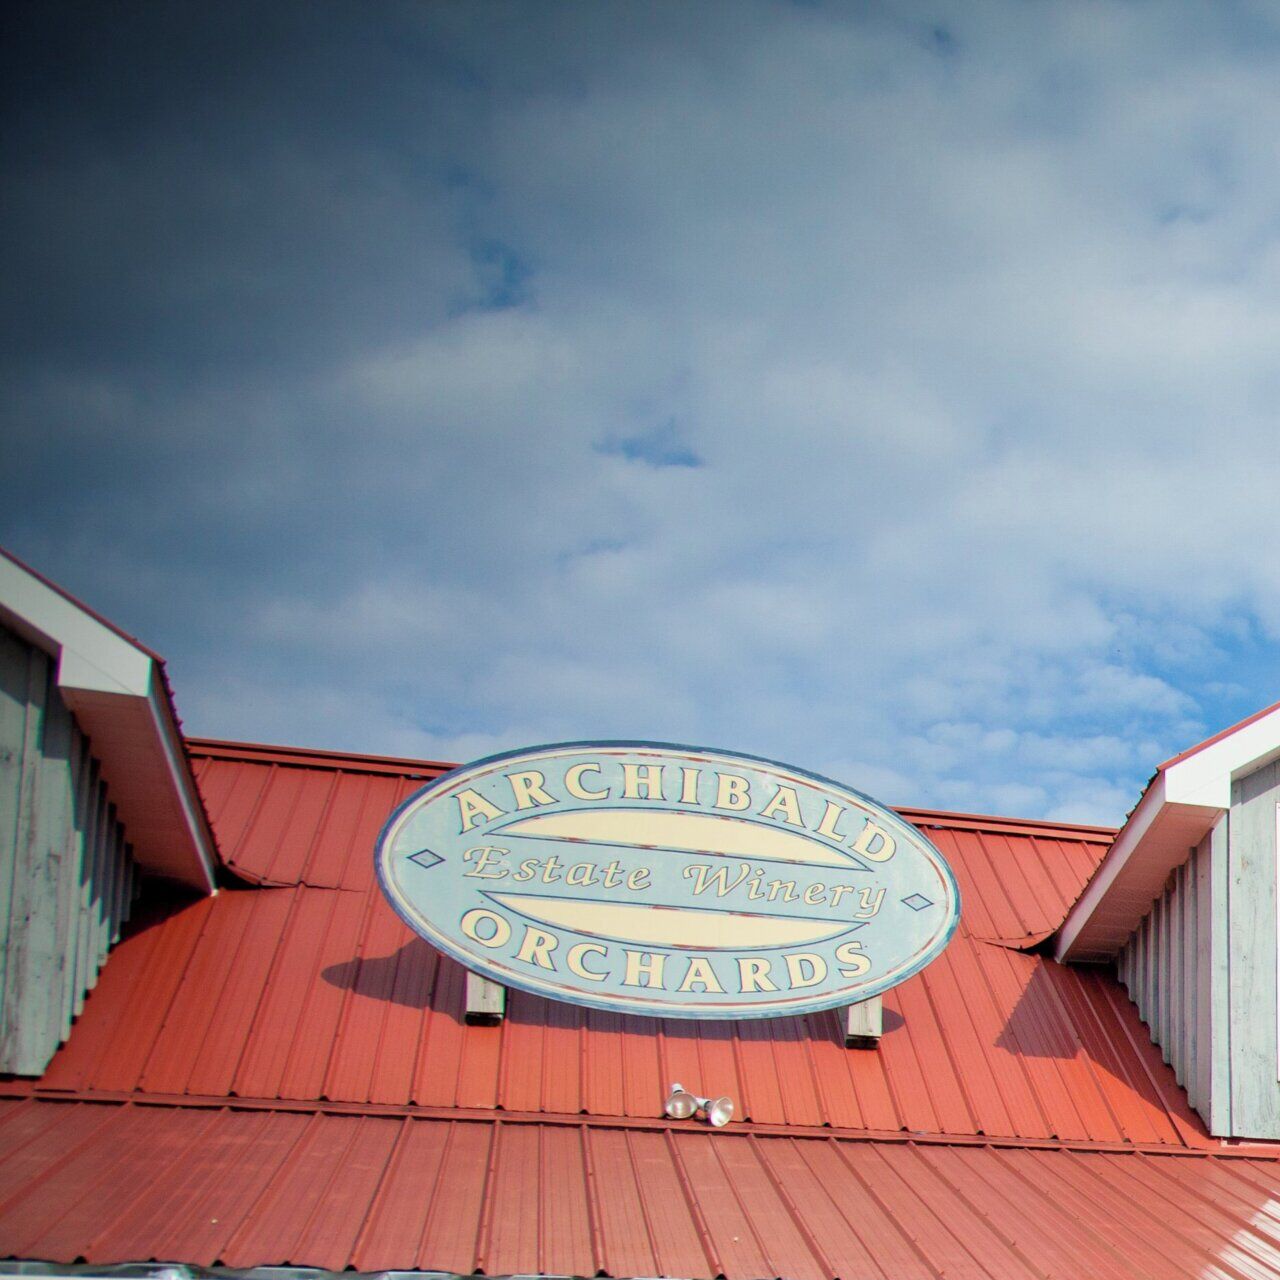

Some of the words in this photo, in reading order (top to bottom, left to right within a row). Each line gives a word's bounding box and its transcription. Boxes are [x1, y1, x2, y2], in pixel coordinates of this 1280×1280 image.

[451, 762, 897, 864] ARCHIBALD
[462, 846, 652, 892] Estate
[682, 864, 887, 920] Winery
[459, 908, 872, 994] ORCHARDS
